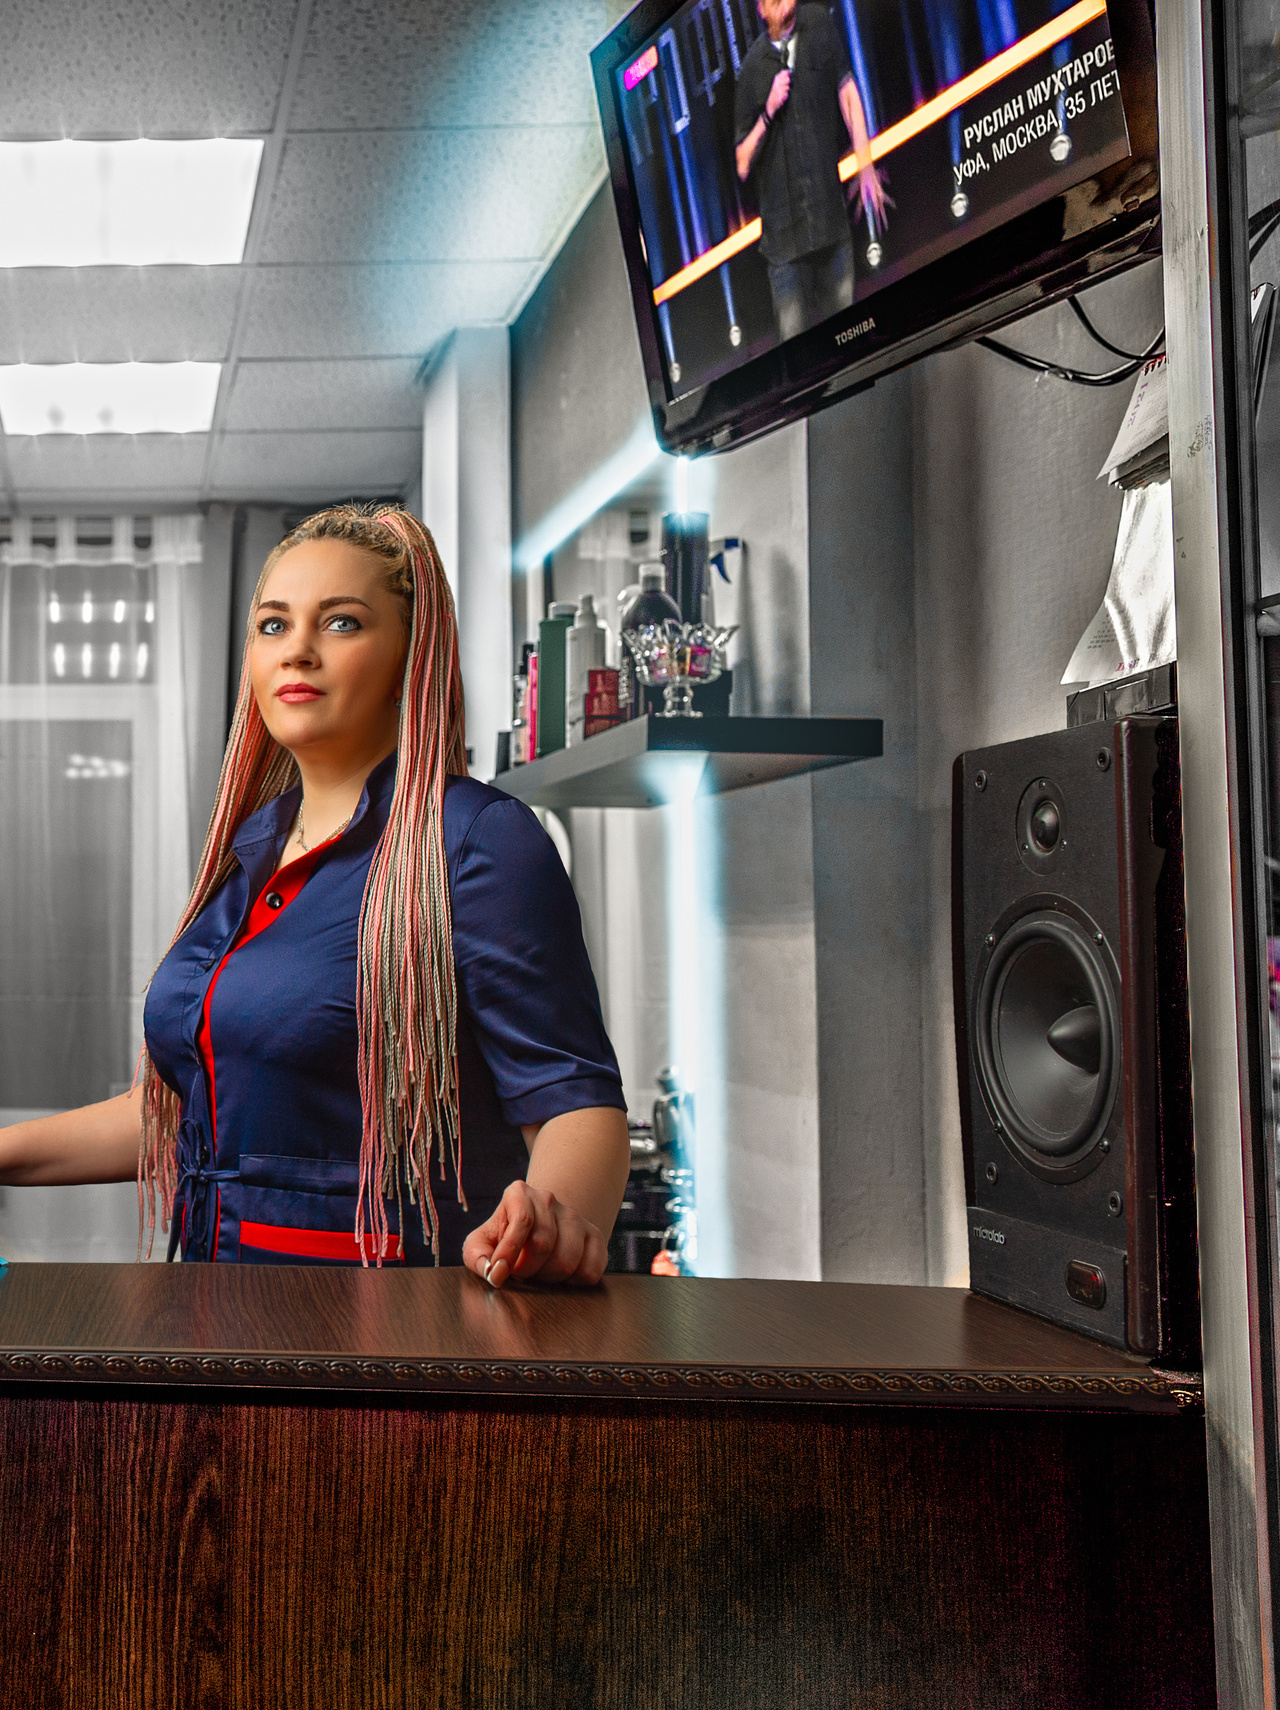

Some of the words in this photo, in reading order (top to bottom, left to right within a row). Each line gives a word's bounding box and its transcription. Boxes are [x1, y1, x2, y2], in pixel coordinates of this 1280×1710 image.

[953, 152, 990, 186] УФА,
[991, 109, 1063, 163] МОСКВА,
[1065, 90, 1086, 119] 35
[1090, 69, 1121, 106] ЛЕТ
[963, 94, 1025, 149] РУСЛАН
[834, 317, 876, 346] TOSHIBA
